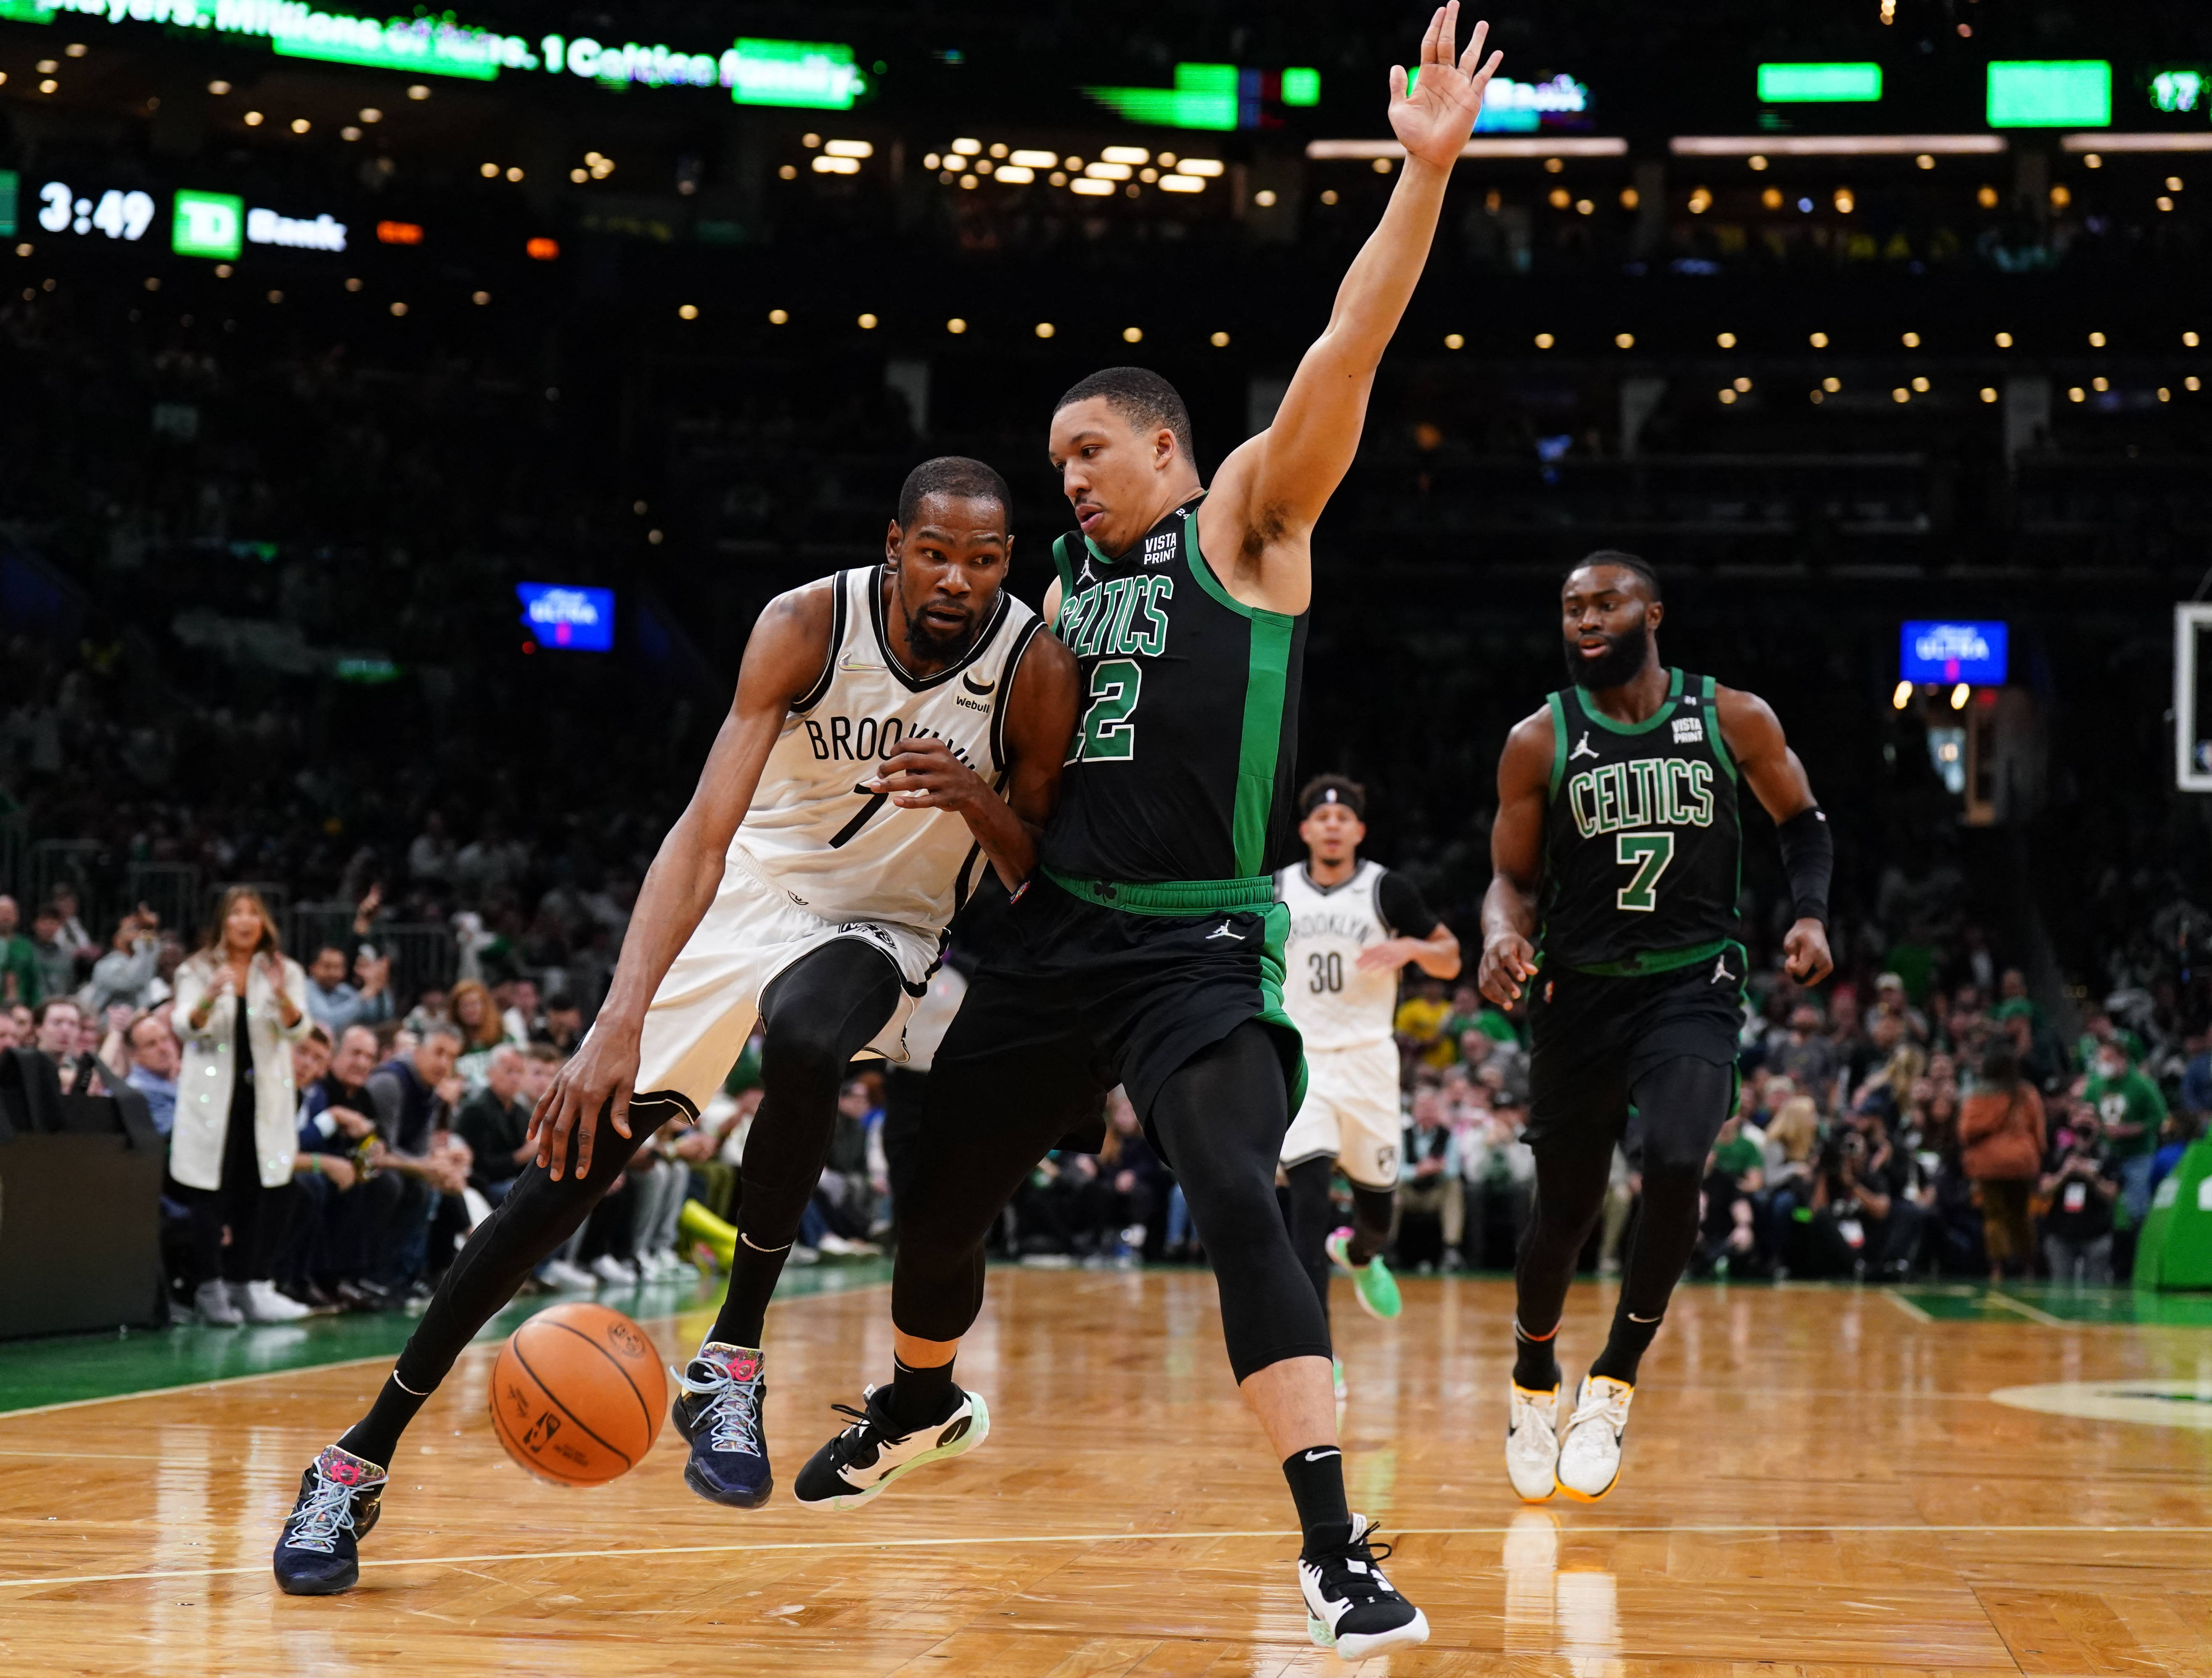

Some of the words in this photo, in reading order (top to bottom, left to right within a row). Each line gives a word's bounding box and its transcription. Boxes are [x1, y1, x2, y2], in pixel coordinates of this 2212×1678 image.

[38, 181, 155, 241] 3:49
[180, 200, 237, 246] TD
[1175, 508, 1191, 520] 24
[1143, 546, 1177, 565] PRINT
[1145, 532, 1177, 553] VISTA
[956, 696, 990, 713] Webull
[1063, 658, 1142, 767] 2
[1671, 717, 1702, 733] VISTA
[805, 716, 976, 771] BROO
[1673, 729, 1703, 744] PRINT
[828, 782, 889, 850] 7
[1569, 758, 1714, 839] CELTICS
[1617, 831, 1675, 912] 7
[1308, 951, 1344, 994] 30
